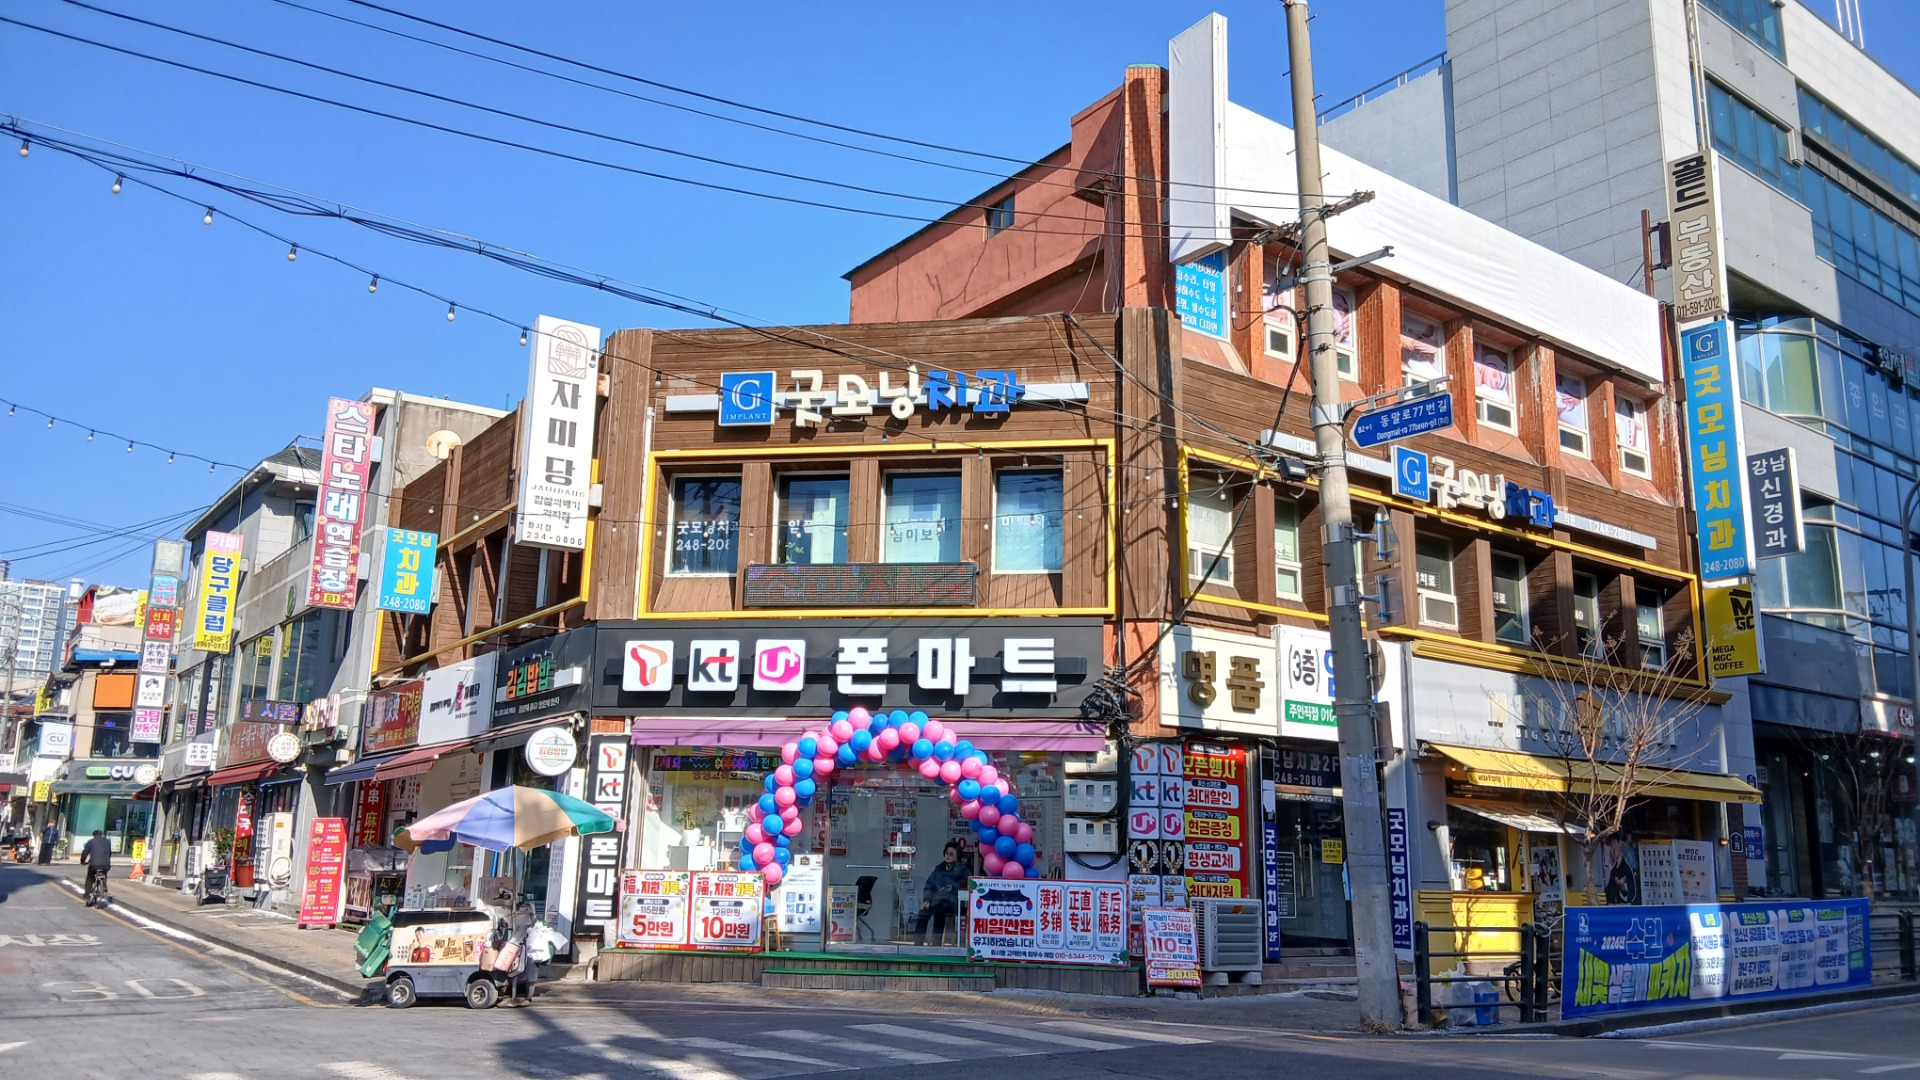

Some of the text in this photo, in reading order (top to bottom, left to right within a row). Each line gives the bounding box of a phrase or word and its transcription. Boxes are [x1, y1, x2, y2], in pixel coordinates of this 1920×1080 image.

[1672, 155, 1709, 212] 골드
[1677, 215, 1714, 300] 부동산
[1676, 297, 1720, 317] 011-591-2012
[726, 412, 767, 420] IMPLANT
[545, 379, 582, 487] 자미당
[1377, 427, 1408, 440] Dongmal-ro
[1408, 418, 1437, 433] 77beon-gil
[1694, 364, 1736, 550] 굿모닝치과
[1752, 455, 1786, 476] 강남
[319, 404, 370, 593] 스타노래연습장
[1400, 485, 1426, 498] IMPLANT
[1761, 477, 1787, 548] 신경과
[526, 531, 583, 546] 234-0806
[394, 547, 420, 595] 치과
[1704, 557, 1744, 574] 248-2080
[204, 556, 233, 633] 당구클럽
[383, 595, 426, 611] 248-2080
[148, 624, 171, 637] 순대국
[1712, 645, 1735, 654] MEGA
[1713, 654, 1732, 662] MGC
[692, 648, 734, 683] kt
[1714, 661, 1744, 671] COFFEE
[506, 659, 551, 699] 김김밥밥
[1182, 650, 1265, 713] 명품
[1289, 703, 1319, 721] 주인직접
[134, 722, 159, 733] 부동산
[1515, 731, 1538, 740] BIG
[112, 765, 135, 779] CU
[1275, 772, 1322, 786] 248-2080
[599, 777, 621, 797] kt
[1131, 780, 1155, 801] kt
[1163, 781, 1180, 802] kt
[1188, 788, 1232, 805] 최대할인
[1188, 820, 1232, 837] 현금증정
[1188, 852, 1233, 868] 평생교체
[1389, 811, 1408, 920] 굿모닝치과
[1678, 854, 1706, 862] DESSERT
[584, 838, 617, 926] 폰마트
[1265, 829, 1278, 927] 굿모닝치과
[1040, 889, 1062, 910] 薄利
[1069, 890, 1092, 911] 正直
[1190, 884, 1233, 898] 최대지원
[1099, 891, 1121, 913] 售后
[712, 908, 740, 917] 128만원
[1040, 912, 1062, 932] 多销
[1069, 912, 1092, 933] 专业
[632, 915, 673, 937] 5만원
[702, 917, 750, 939] 10만원
[974, 918, 1034, 936] 제일싼집
[1099, 914, 1121, 934] 服务
[1160, 922, 1191, 933] 3년이상
[1394, 925, 1409, 936] 2F
[973, 937, 1034, 948] 유지하겠습니다!
[1151, 937, 1177, 954] 110
[1268, 932, 1278, 941] 2F
[1602, 917, 1663, 959] 2026년 수원
[42, 978, 208, 1003] 30
